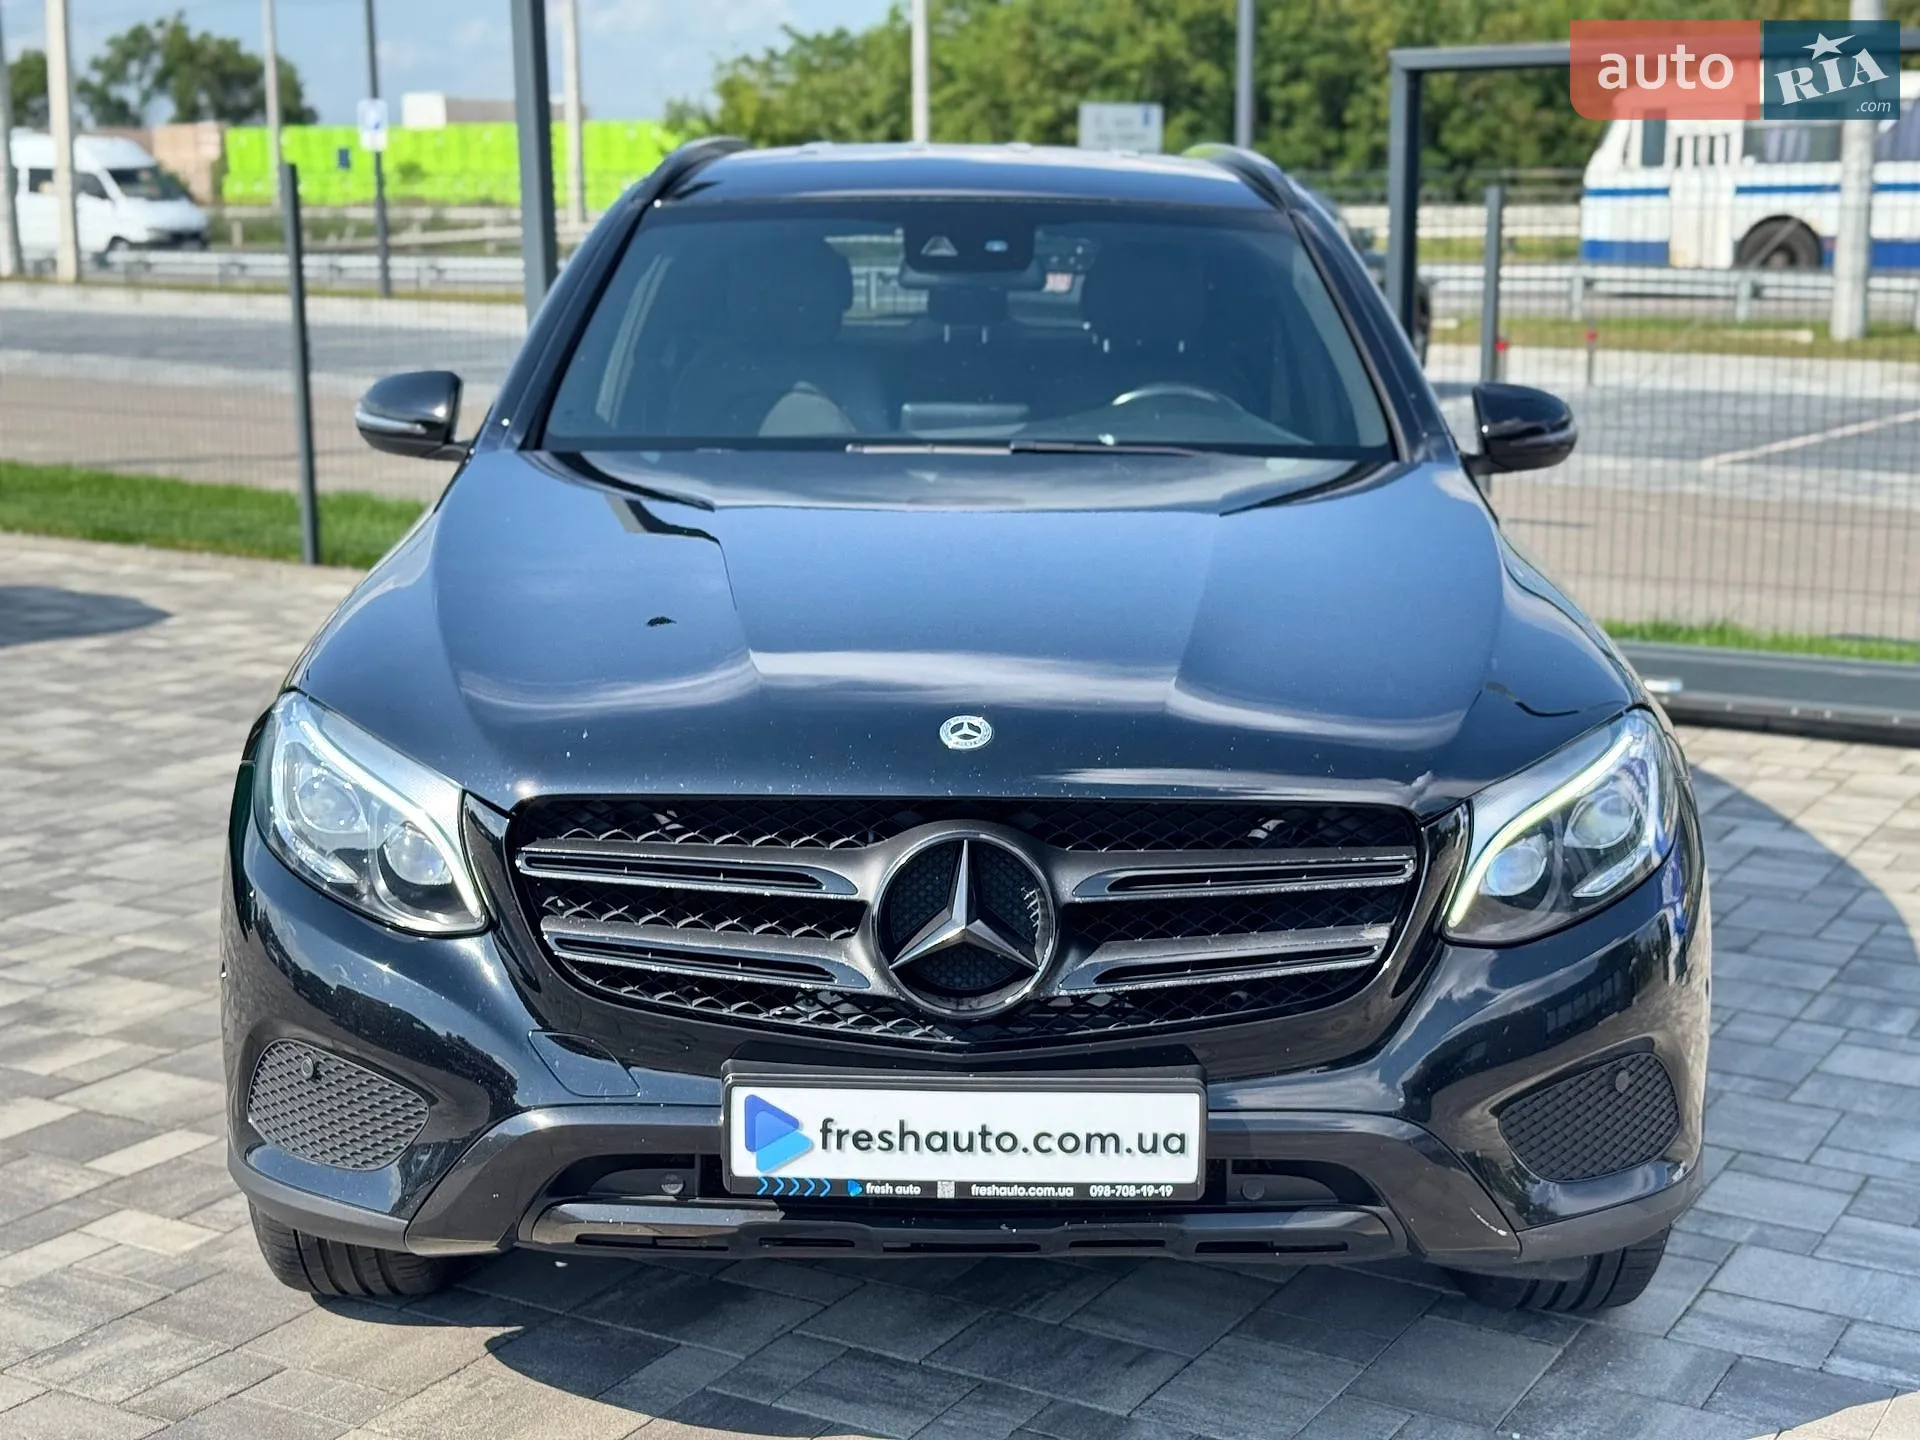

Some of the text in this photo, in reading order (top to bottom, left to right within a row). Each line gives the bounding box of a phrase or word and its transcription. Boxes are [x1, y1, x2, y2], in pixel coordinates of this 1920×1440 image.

[819, 1117, 1187, 1155] freshauto.com.ua
[865, 1182, 1173, 1197] fresh auto freshauto.com.ua 098-708-19-19
